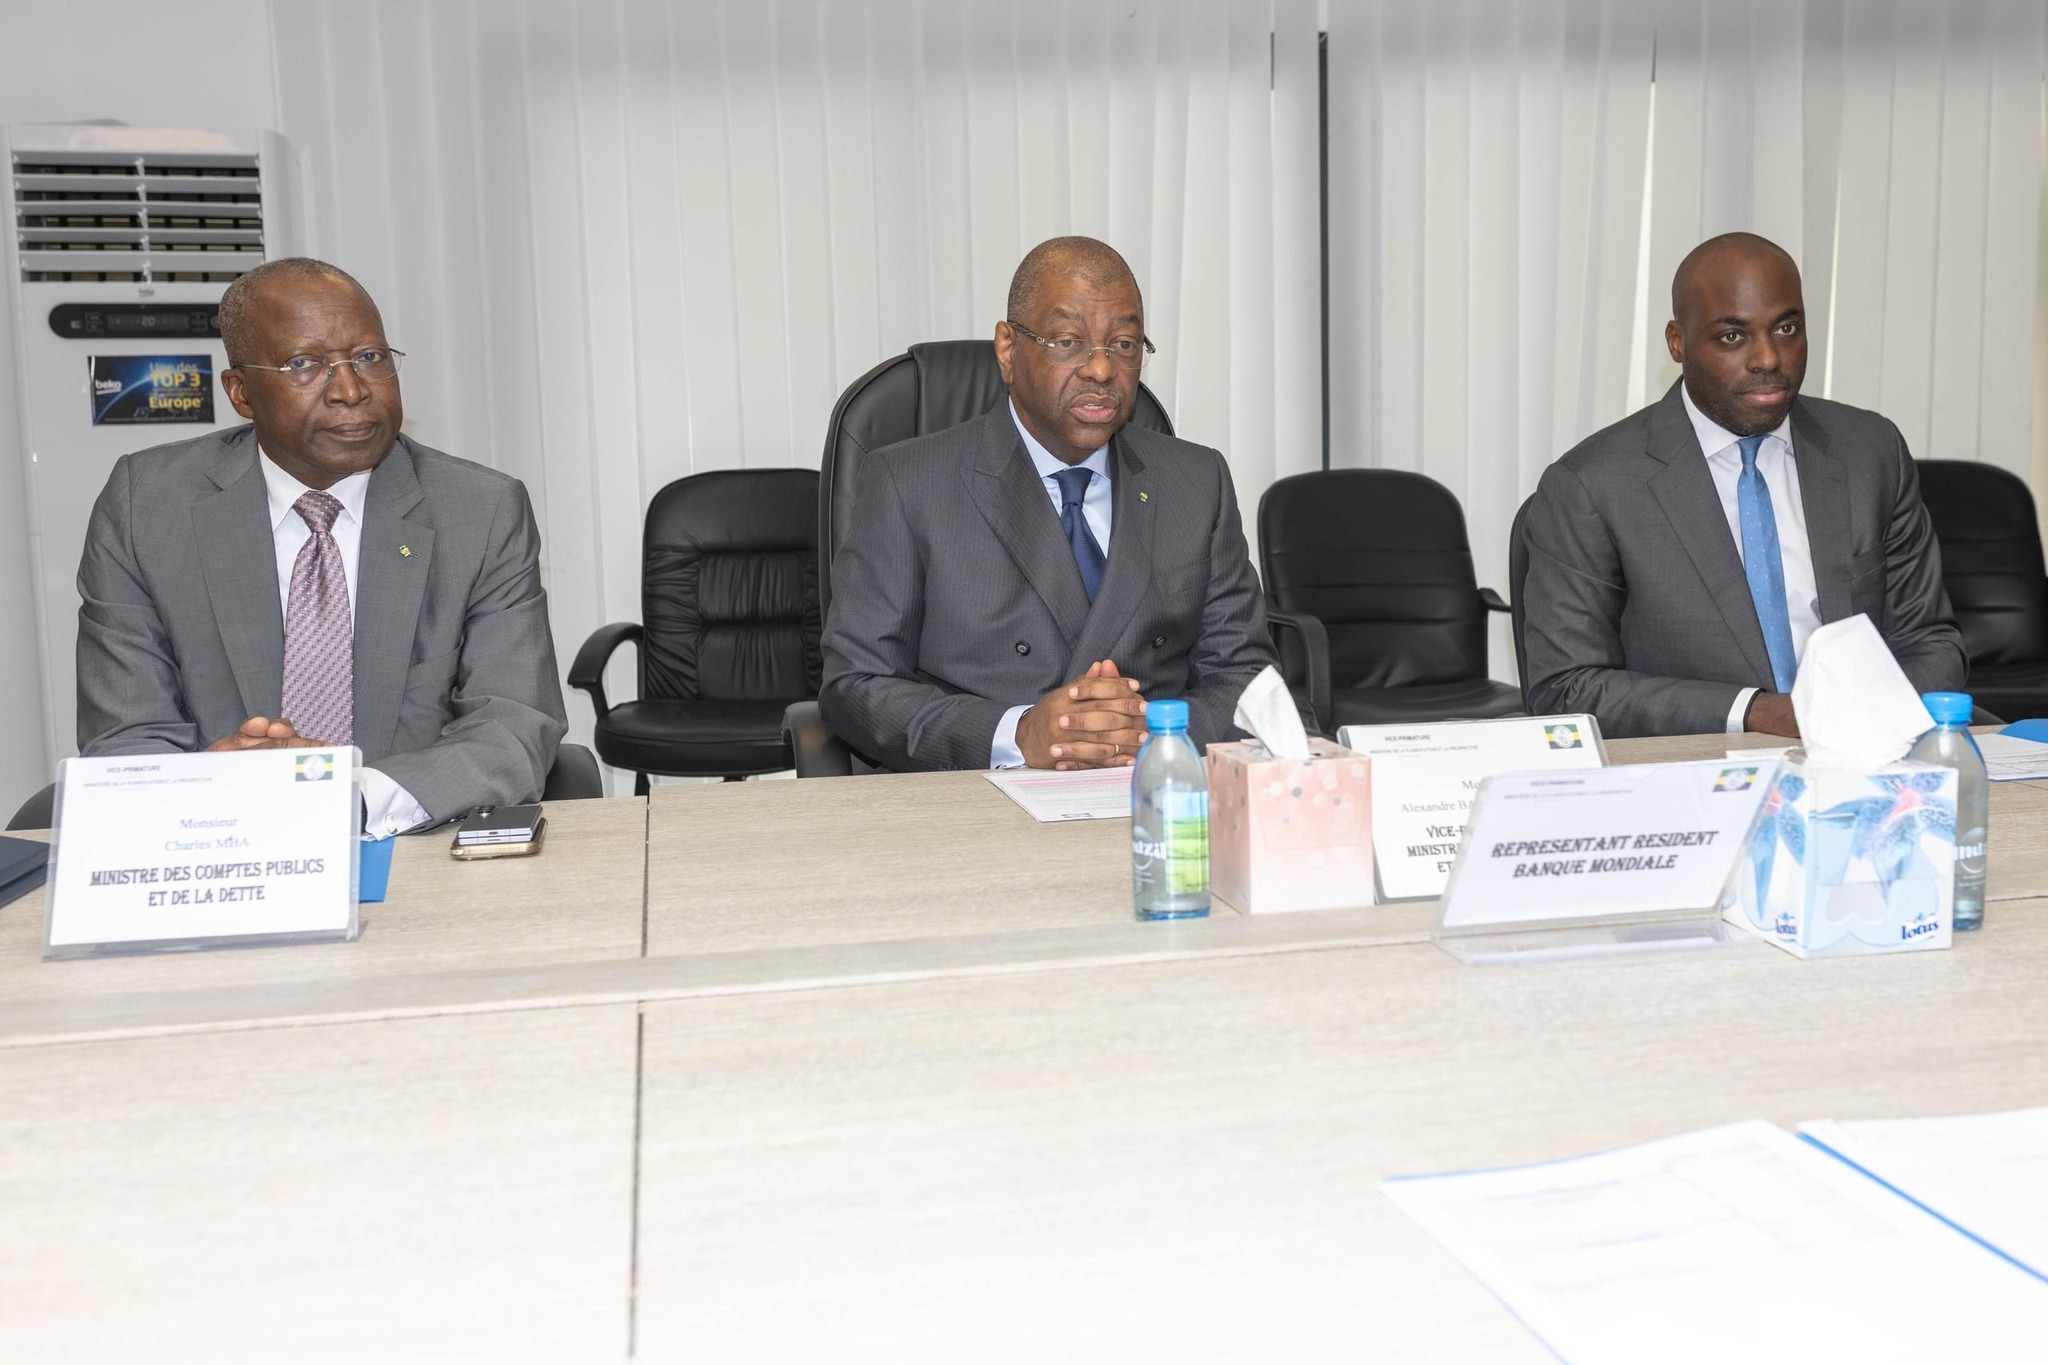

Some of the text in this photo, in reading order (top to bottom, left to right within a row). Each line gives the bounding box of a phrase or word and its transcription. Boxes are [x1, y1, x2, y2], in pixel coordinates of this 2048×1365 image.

[95, 379, 122, 390] beko
[152, 372, 201, 388] TOP 3
[1401, 801, 1456, 813] Alexandre
[179, 818, 239, 830] Monsieur
[164, 839, 212, 852] Charles
[1491, 830, 1719, 858] REPRESENTANT RESIDENT
[90, 858, 325, 887] MINISTRE DES COMPTES PUBLICS
[1437, 861, 1453, 873] ET
[1513, 854, 1678, 878] BANQUE MONDIALE
[148, 885, 266, 907] ET DE LA DETTE
[1901, 920, 1938, 940] lotus
